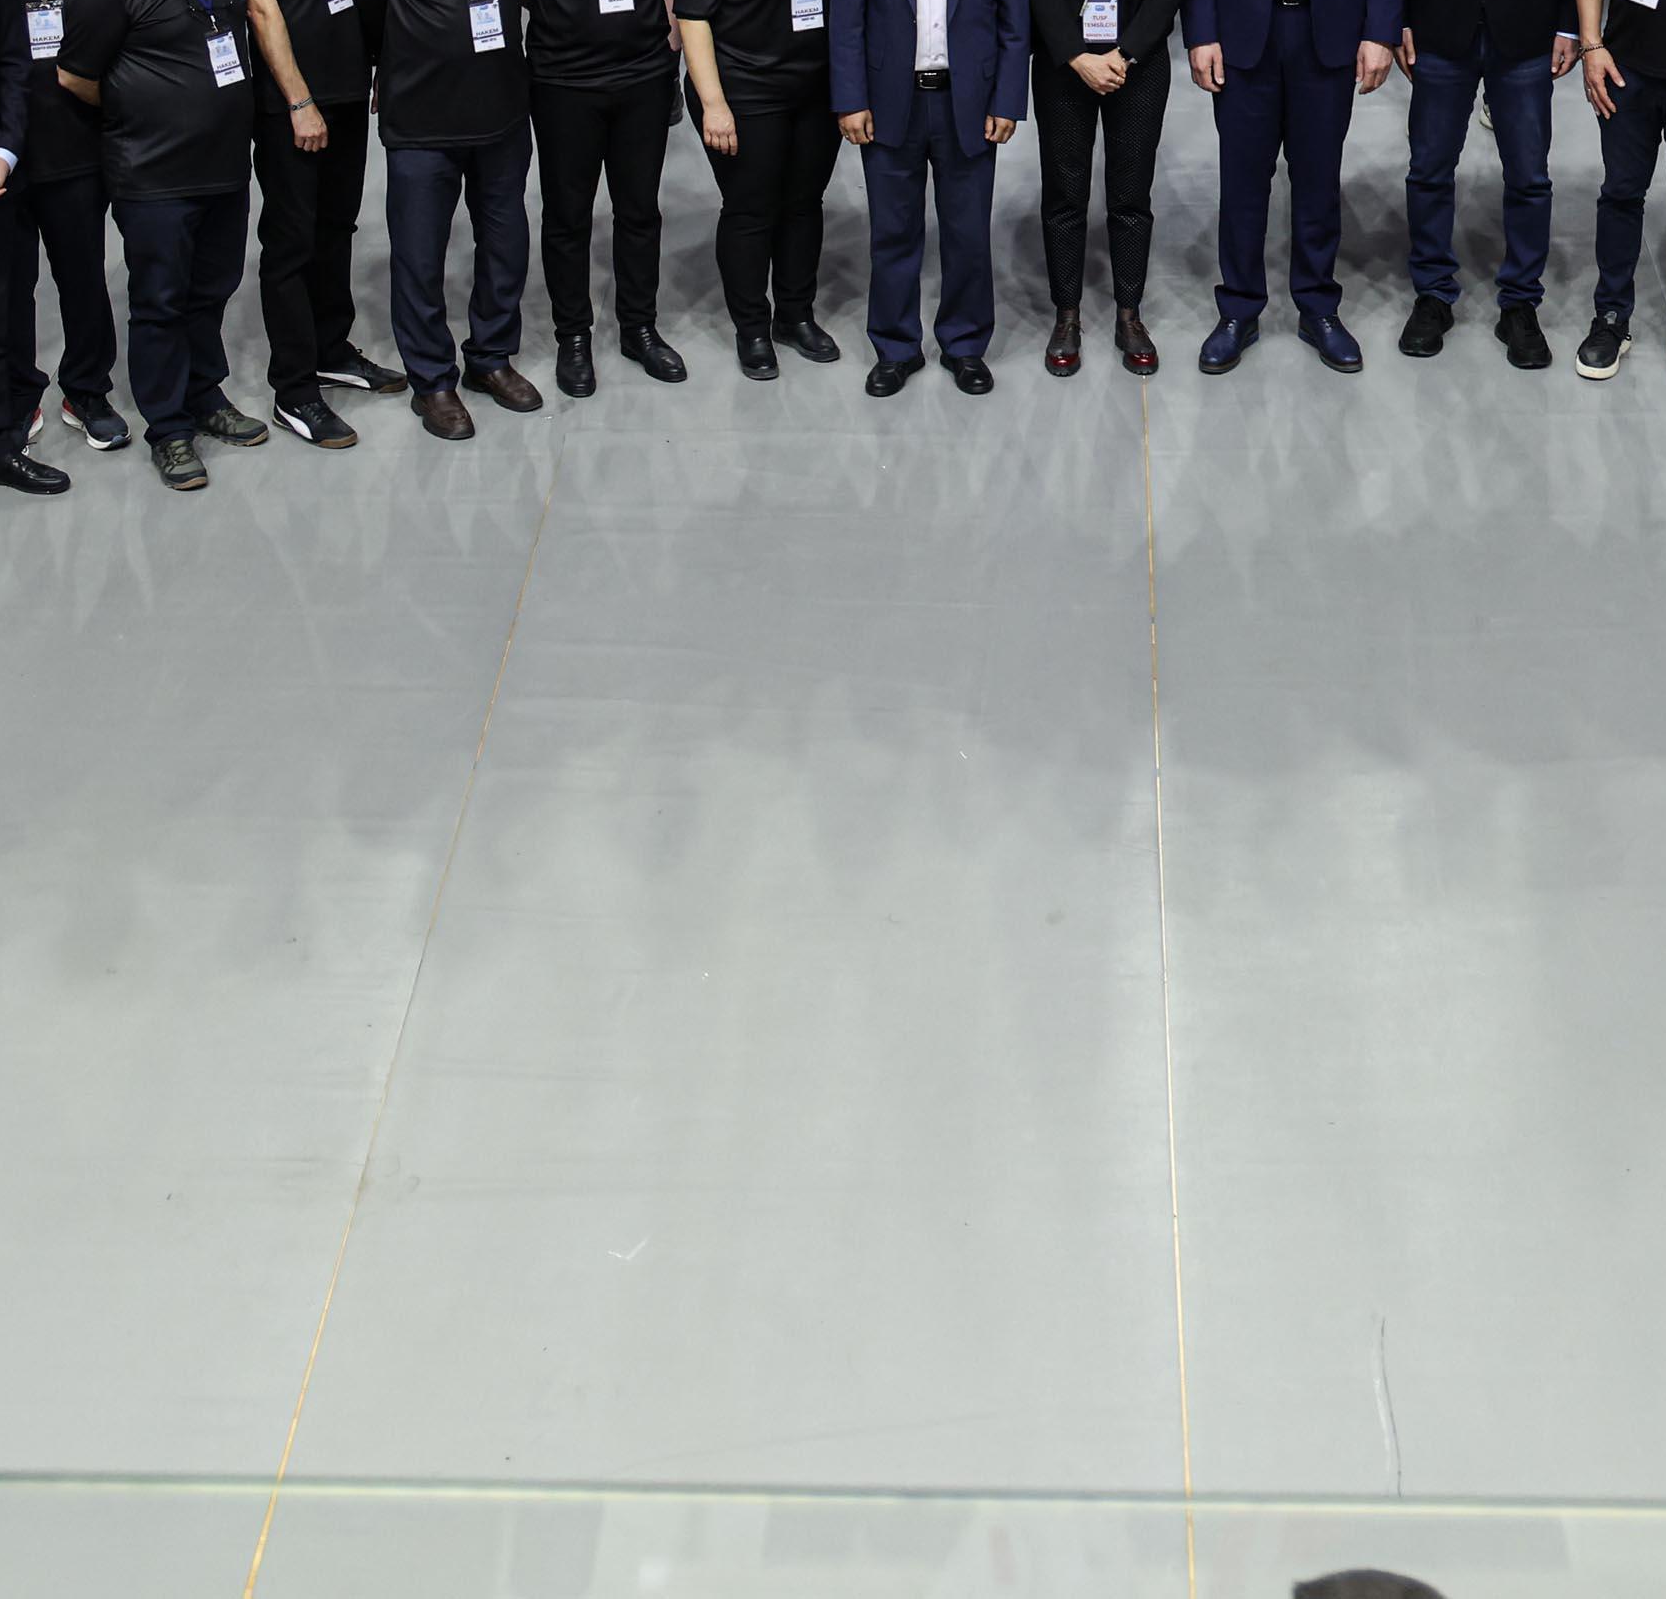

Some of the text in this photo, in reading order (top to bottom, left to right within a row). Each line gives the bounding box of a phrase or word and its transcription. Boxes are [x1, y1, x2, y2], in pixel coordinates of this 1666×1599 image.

[794, 7, 820, 15] HAKEM
[476, 27, 500, 37] HAKEM
[32, 34, 61, 43] HAKEM
[215, 60, 238, 71] HAKEM
